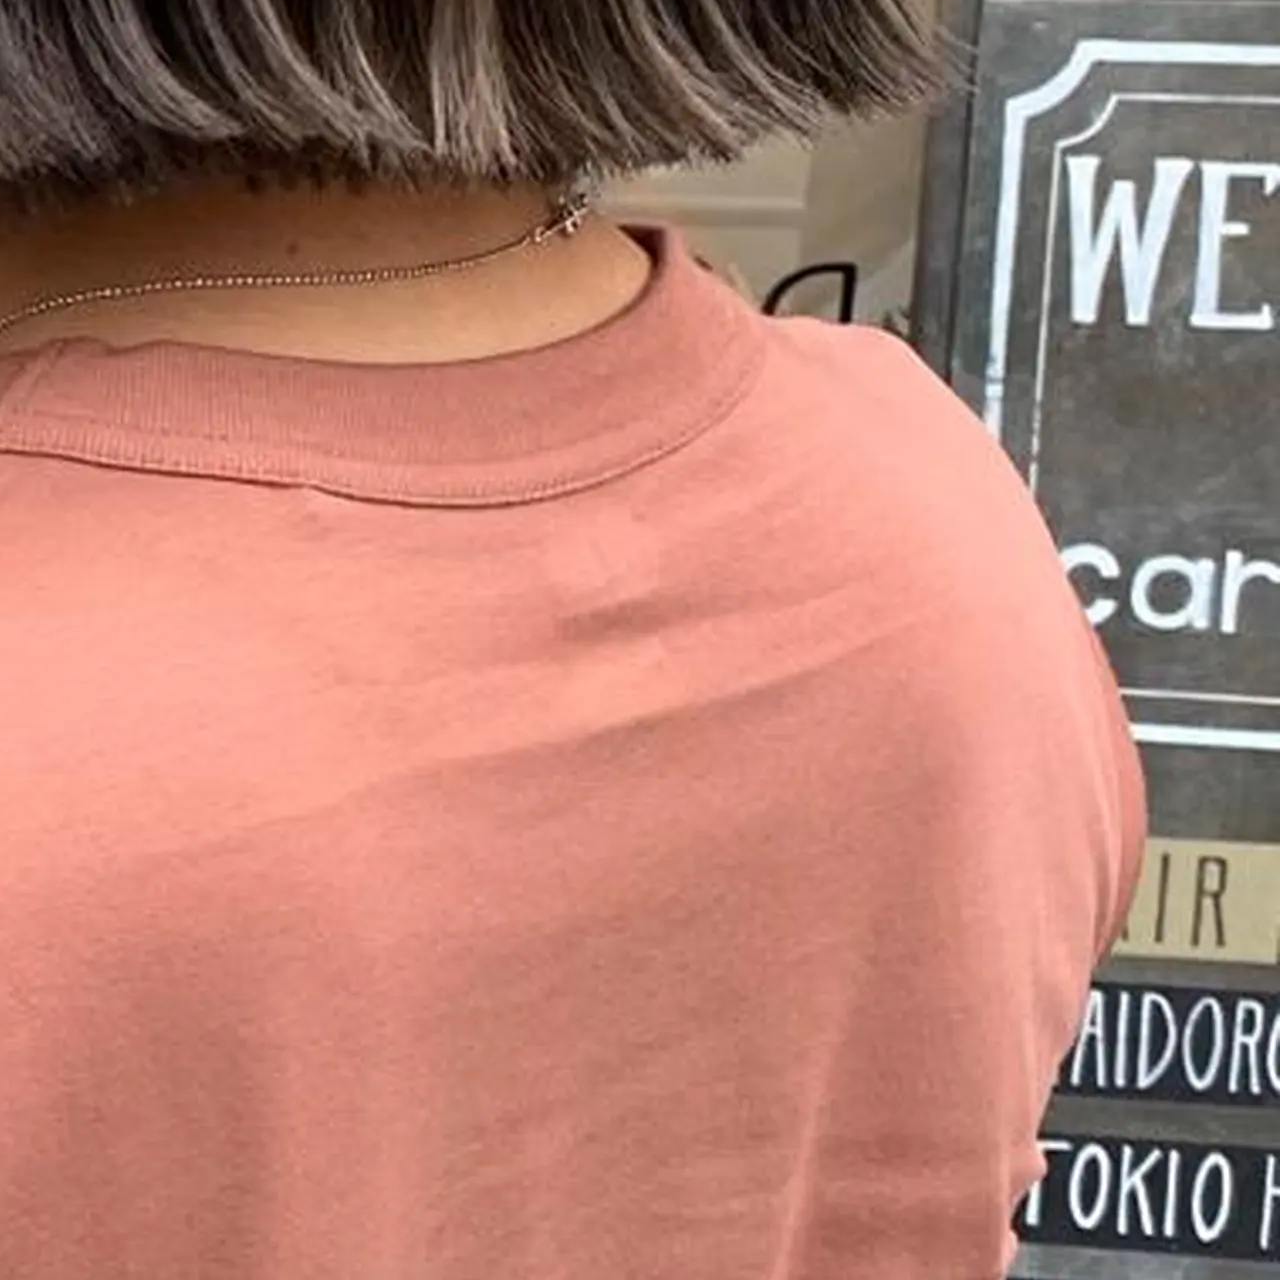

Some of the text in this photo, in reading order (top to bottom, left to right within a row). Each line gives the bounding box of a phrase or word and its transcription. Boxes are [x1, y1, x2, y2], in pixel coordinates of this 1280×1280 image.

[1066, 156, 1280, 330] WE
[1122, 852, 1226, 947] IR
[1026, 1140, 1232, 1242] TOKIO
